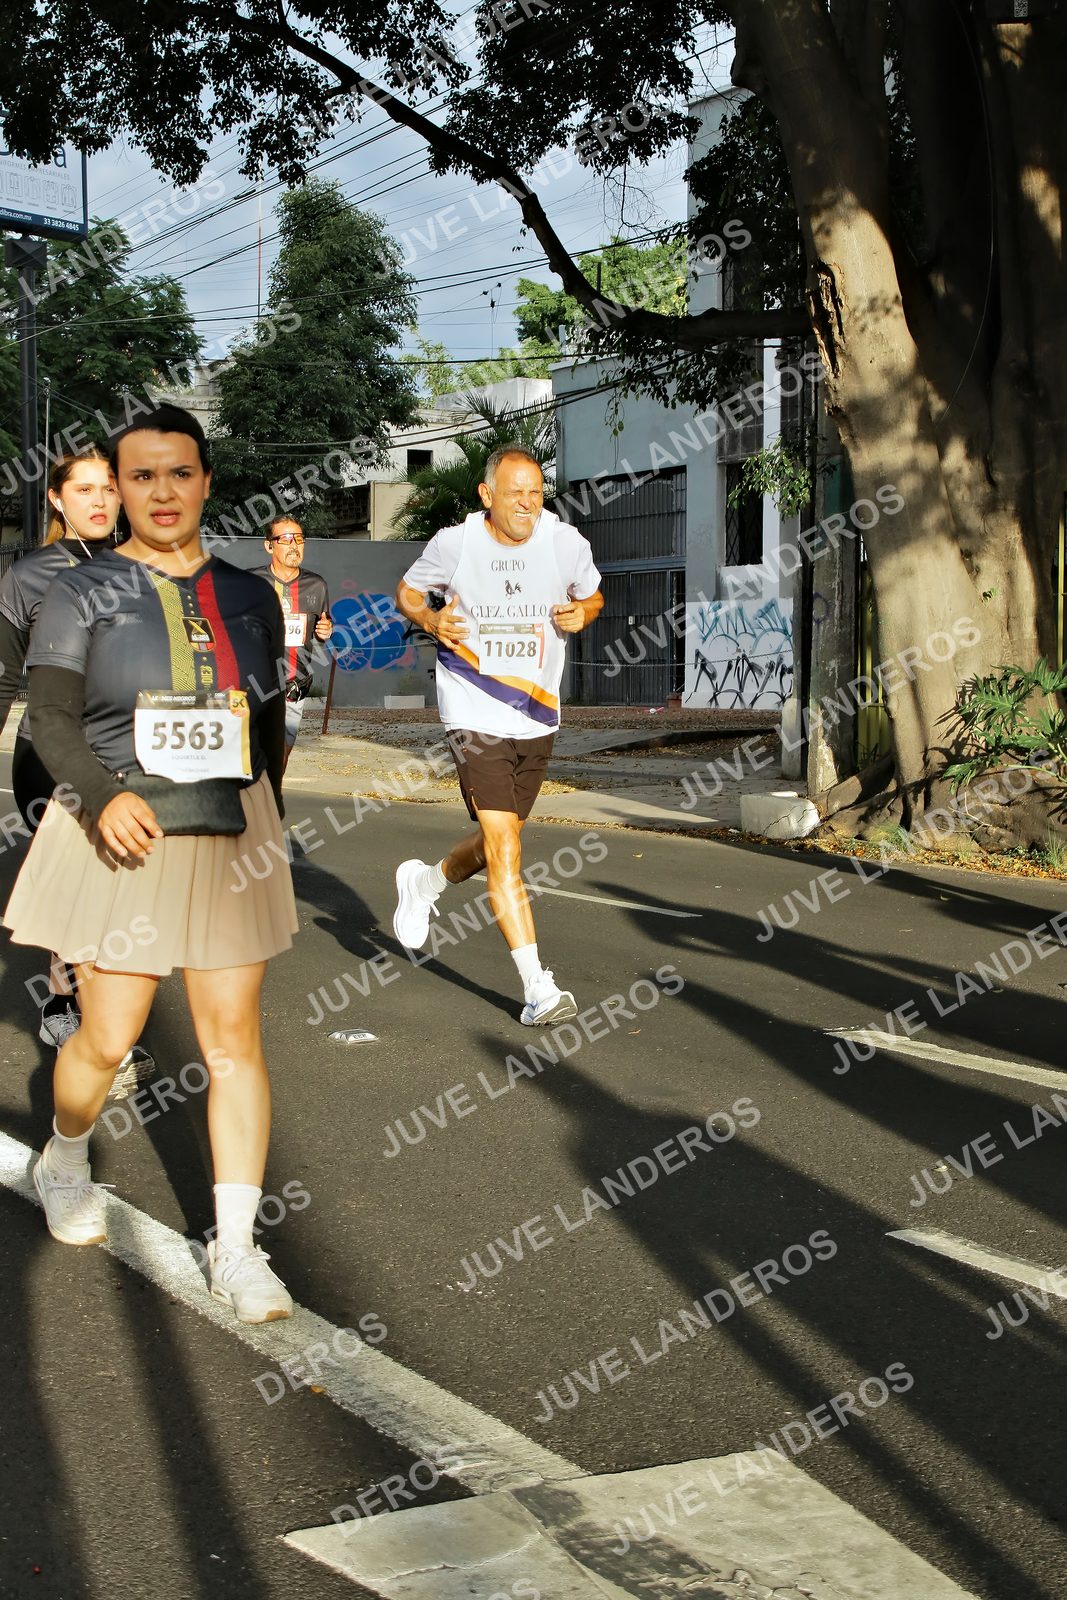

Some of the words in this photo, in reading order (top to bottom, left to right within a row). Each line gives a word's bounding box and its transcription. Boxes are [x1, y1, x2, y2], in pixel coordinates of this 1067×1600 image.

[491, 559, 525, 571] GRUPO
[507, 604, 547, 618] GALLO
[485, 640, 537, 658] 11028
[151, 721, 224, 750] 5563
